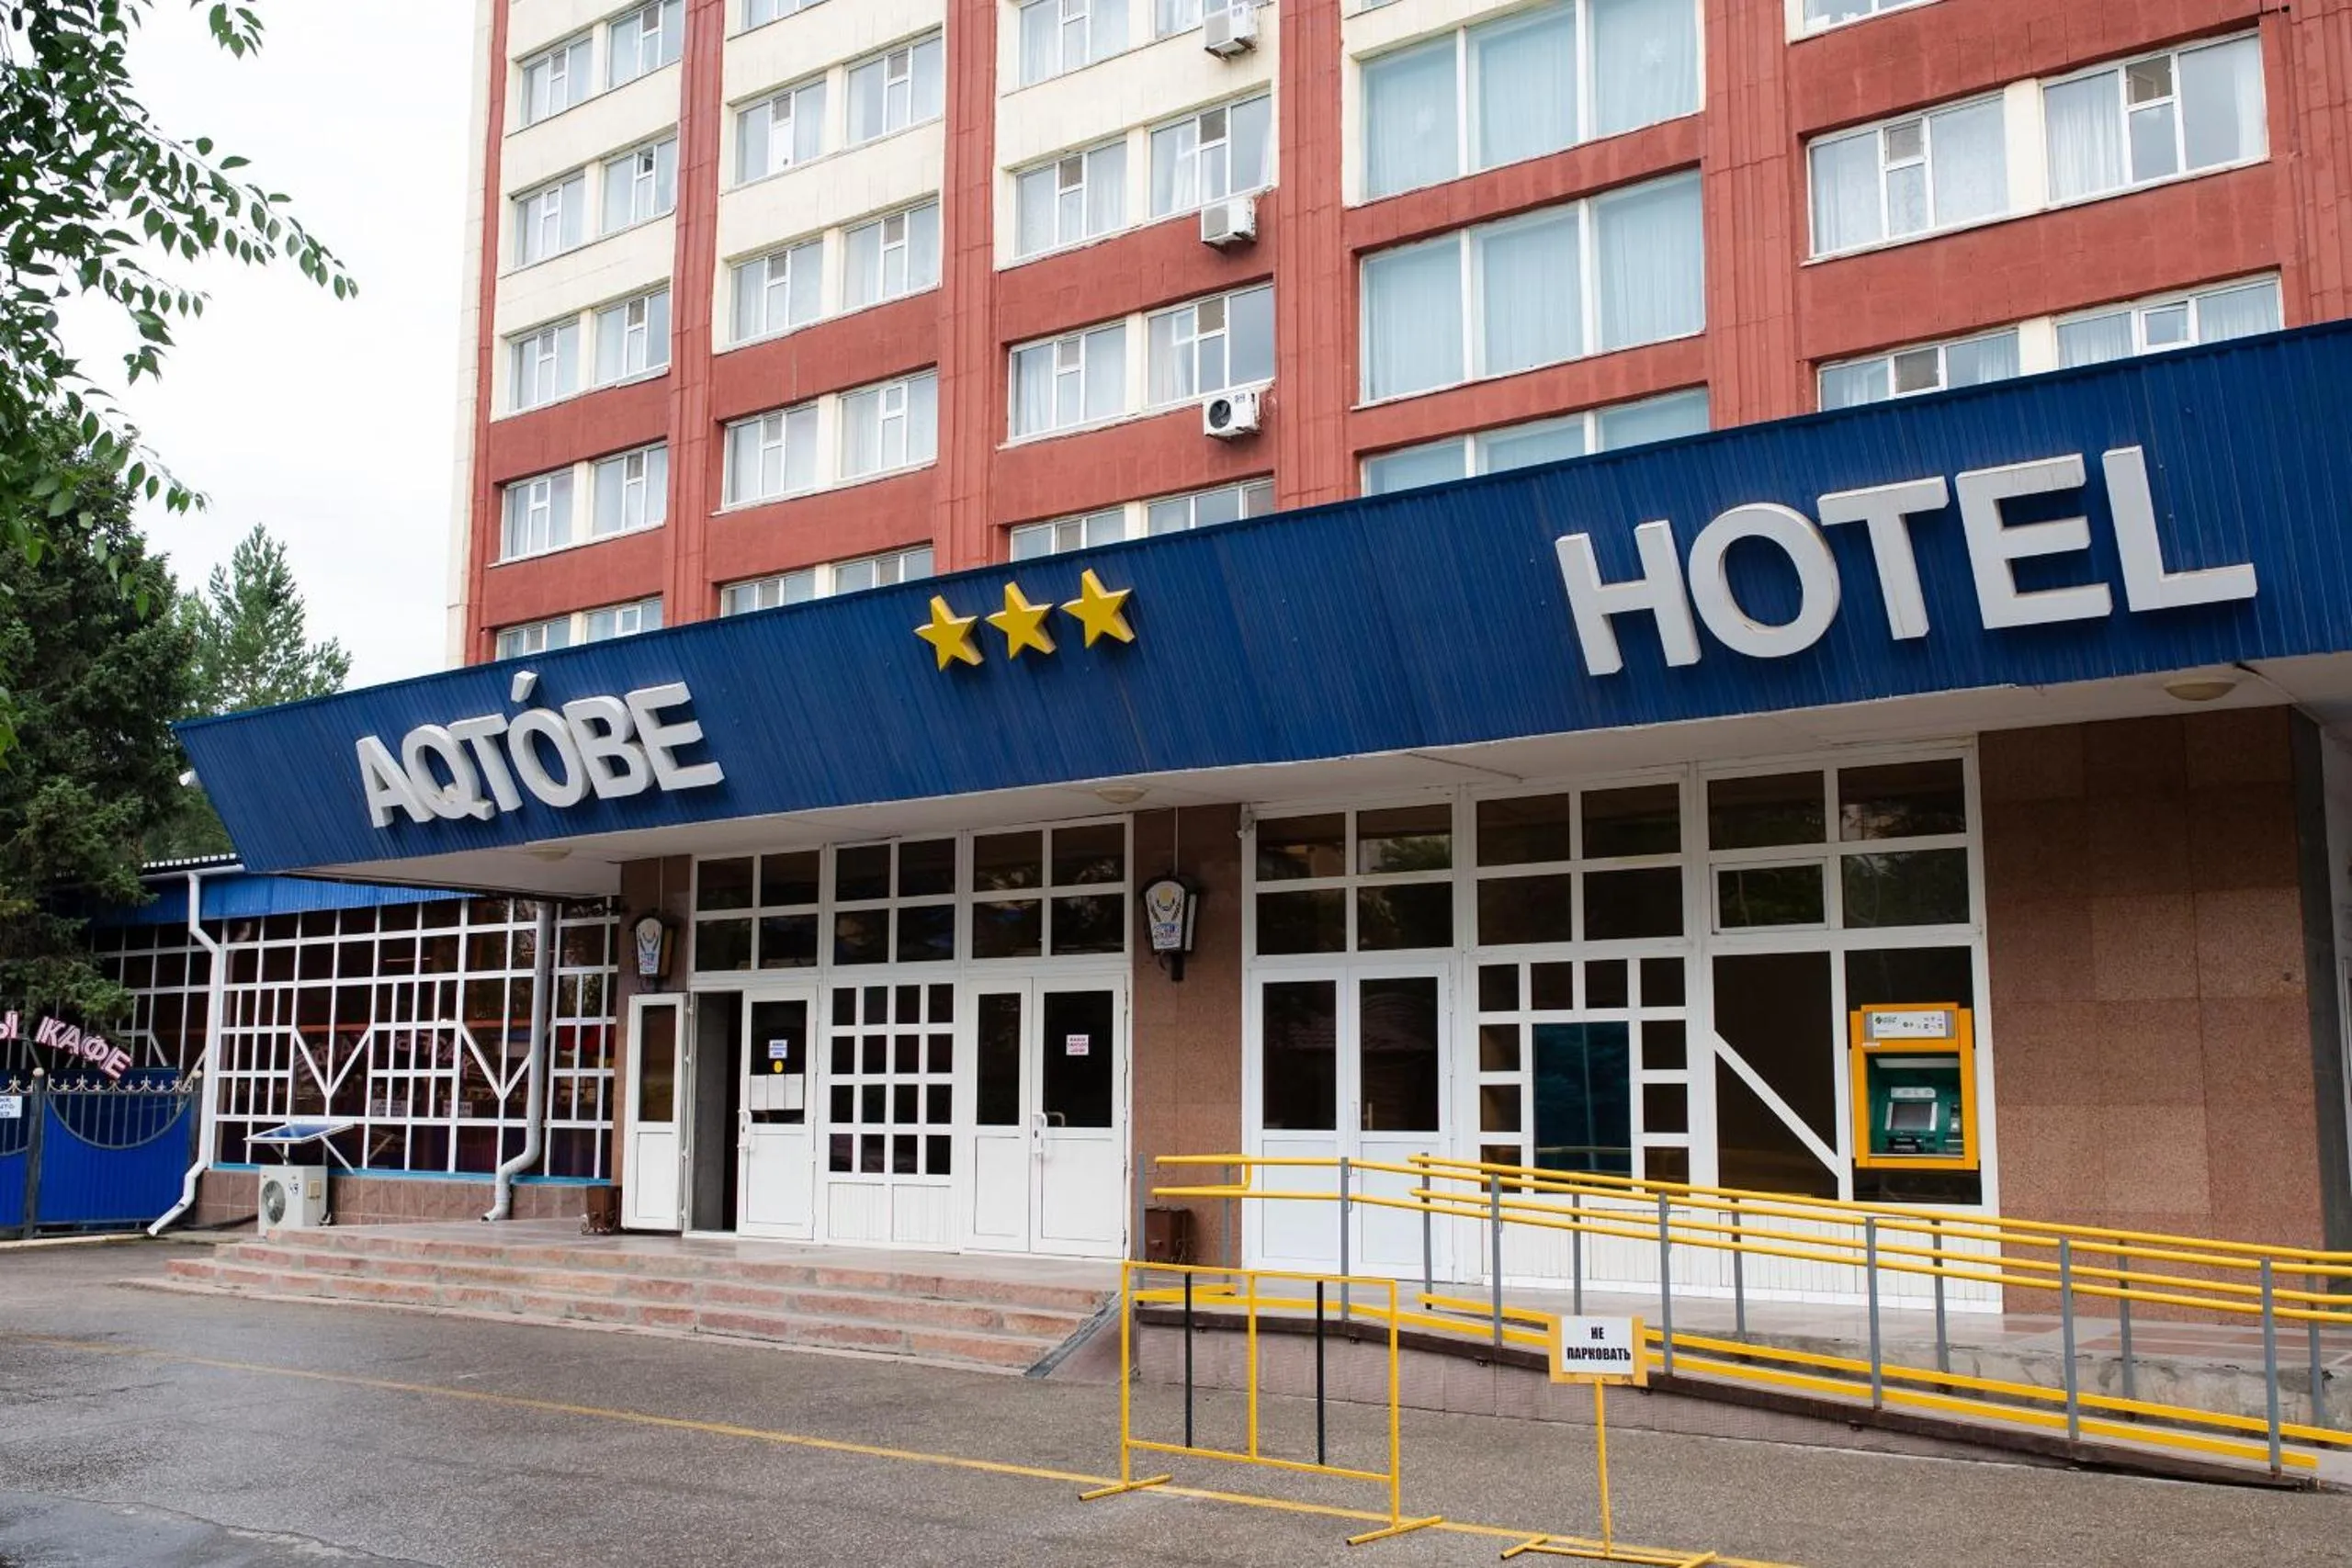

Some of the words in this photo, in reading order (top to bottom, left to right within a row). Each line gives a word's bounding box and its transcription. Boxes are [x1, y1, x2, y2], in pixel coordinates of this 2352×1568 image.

[1555, 446, 2257, 676] HOTEL
[356, 671, 725, 828] AQTÓBE
[36, 1016, 133, 1079] КАФЕ
[1566, 1347, 1631, 1361] ПАРКОВАТЬ
[1590, 1326, 1604, 1339] НЕ
